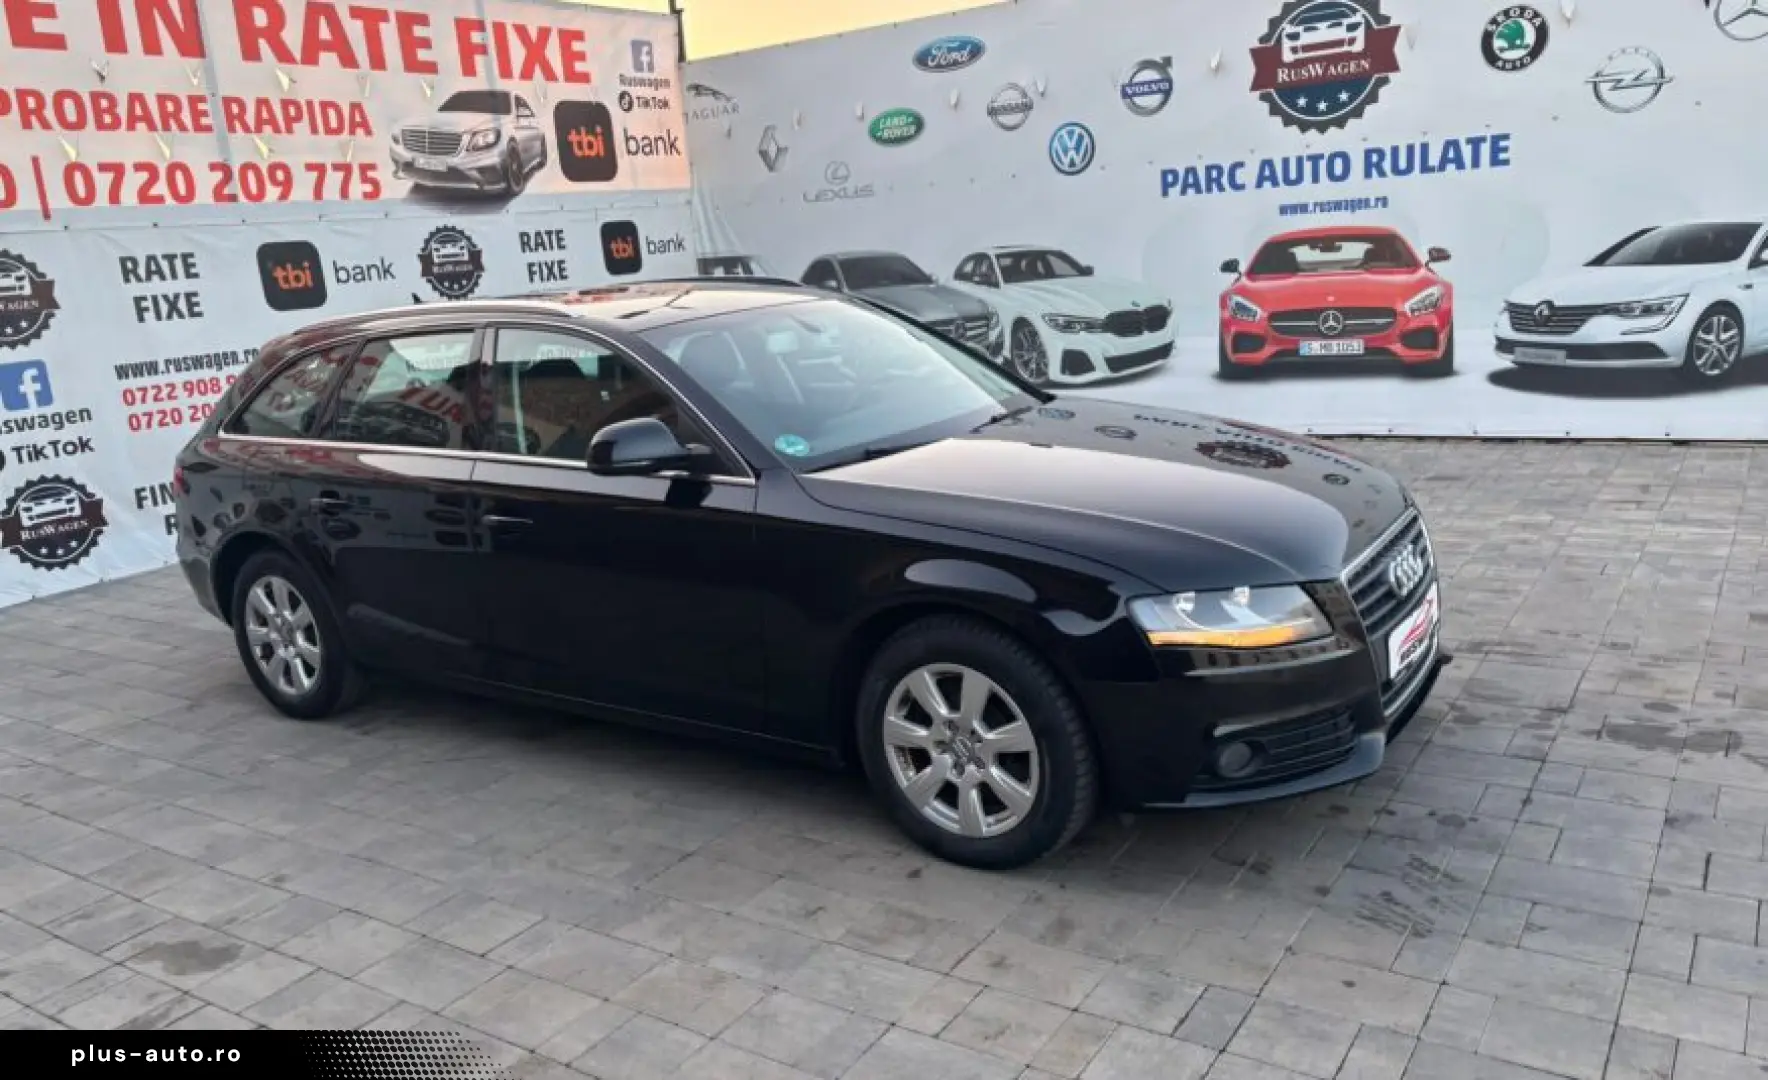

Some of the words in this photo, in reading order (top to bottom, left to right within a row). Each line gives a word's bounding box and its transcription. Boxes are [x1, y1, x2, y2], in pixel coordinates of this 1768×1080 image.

[96, 0, 207, 59] IN
[233, 0, 438, 75] RATE
[454, 17, 591, 84] FIXE
[927, 43, 972, 67] Ford
[1125, 82, 1169, 94] VOLVO
[222, 96, 373, 137] RAPIDA
[567, 125, 605, 157] tbi
[623, 127, 682, 157] bank
[1160, 161, 1246, 198] PARC
[1255, 150, 1351, 189] AUTO
[1364, 133, 1511, 180] RULATE
[63, 161, 196, 207] 0720
[208, 160, 293, 203] 209
[305, 162, 382, 201] 775
[1279, 196, 1389, 216] www.ruswagen.ro
[518, 229, 567, 253] RATE
[610, 235, 635, 259] tbi
[646, 233, 686, 255] bank
[119, 252, 200, 284] RATE
[272, 260, 314, 290] tbi
[333, 256, 397, 285] bank
[527, 260, 569, 283] FIXE
[133, 291, 204, 323] FIXE
[122, 383, 178, 406] 0722
[182, 377, 222, 398] 908
[0, 408, 92, 434] swagen
[128, 408, 183, 432] 0720
[10, 436, 95, 464] TikTok
